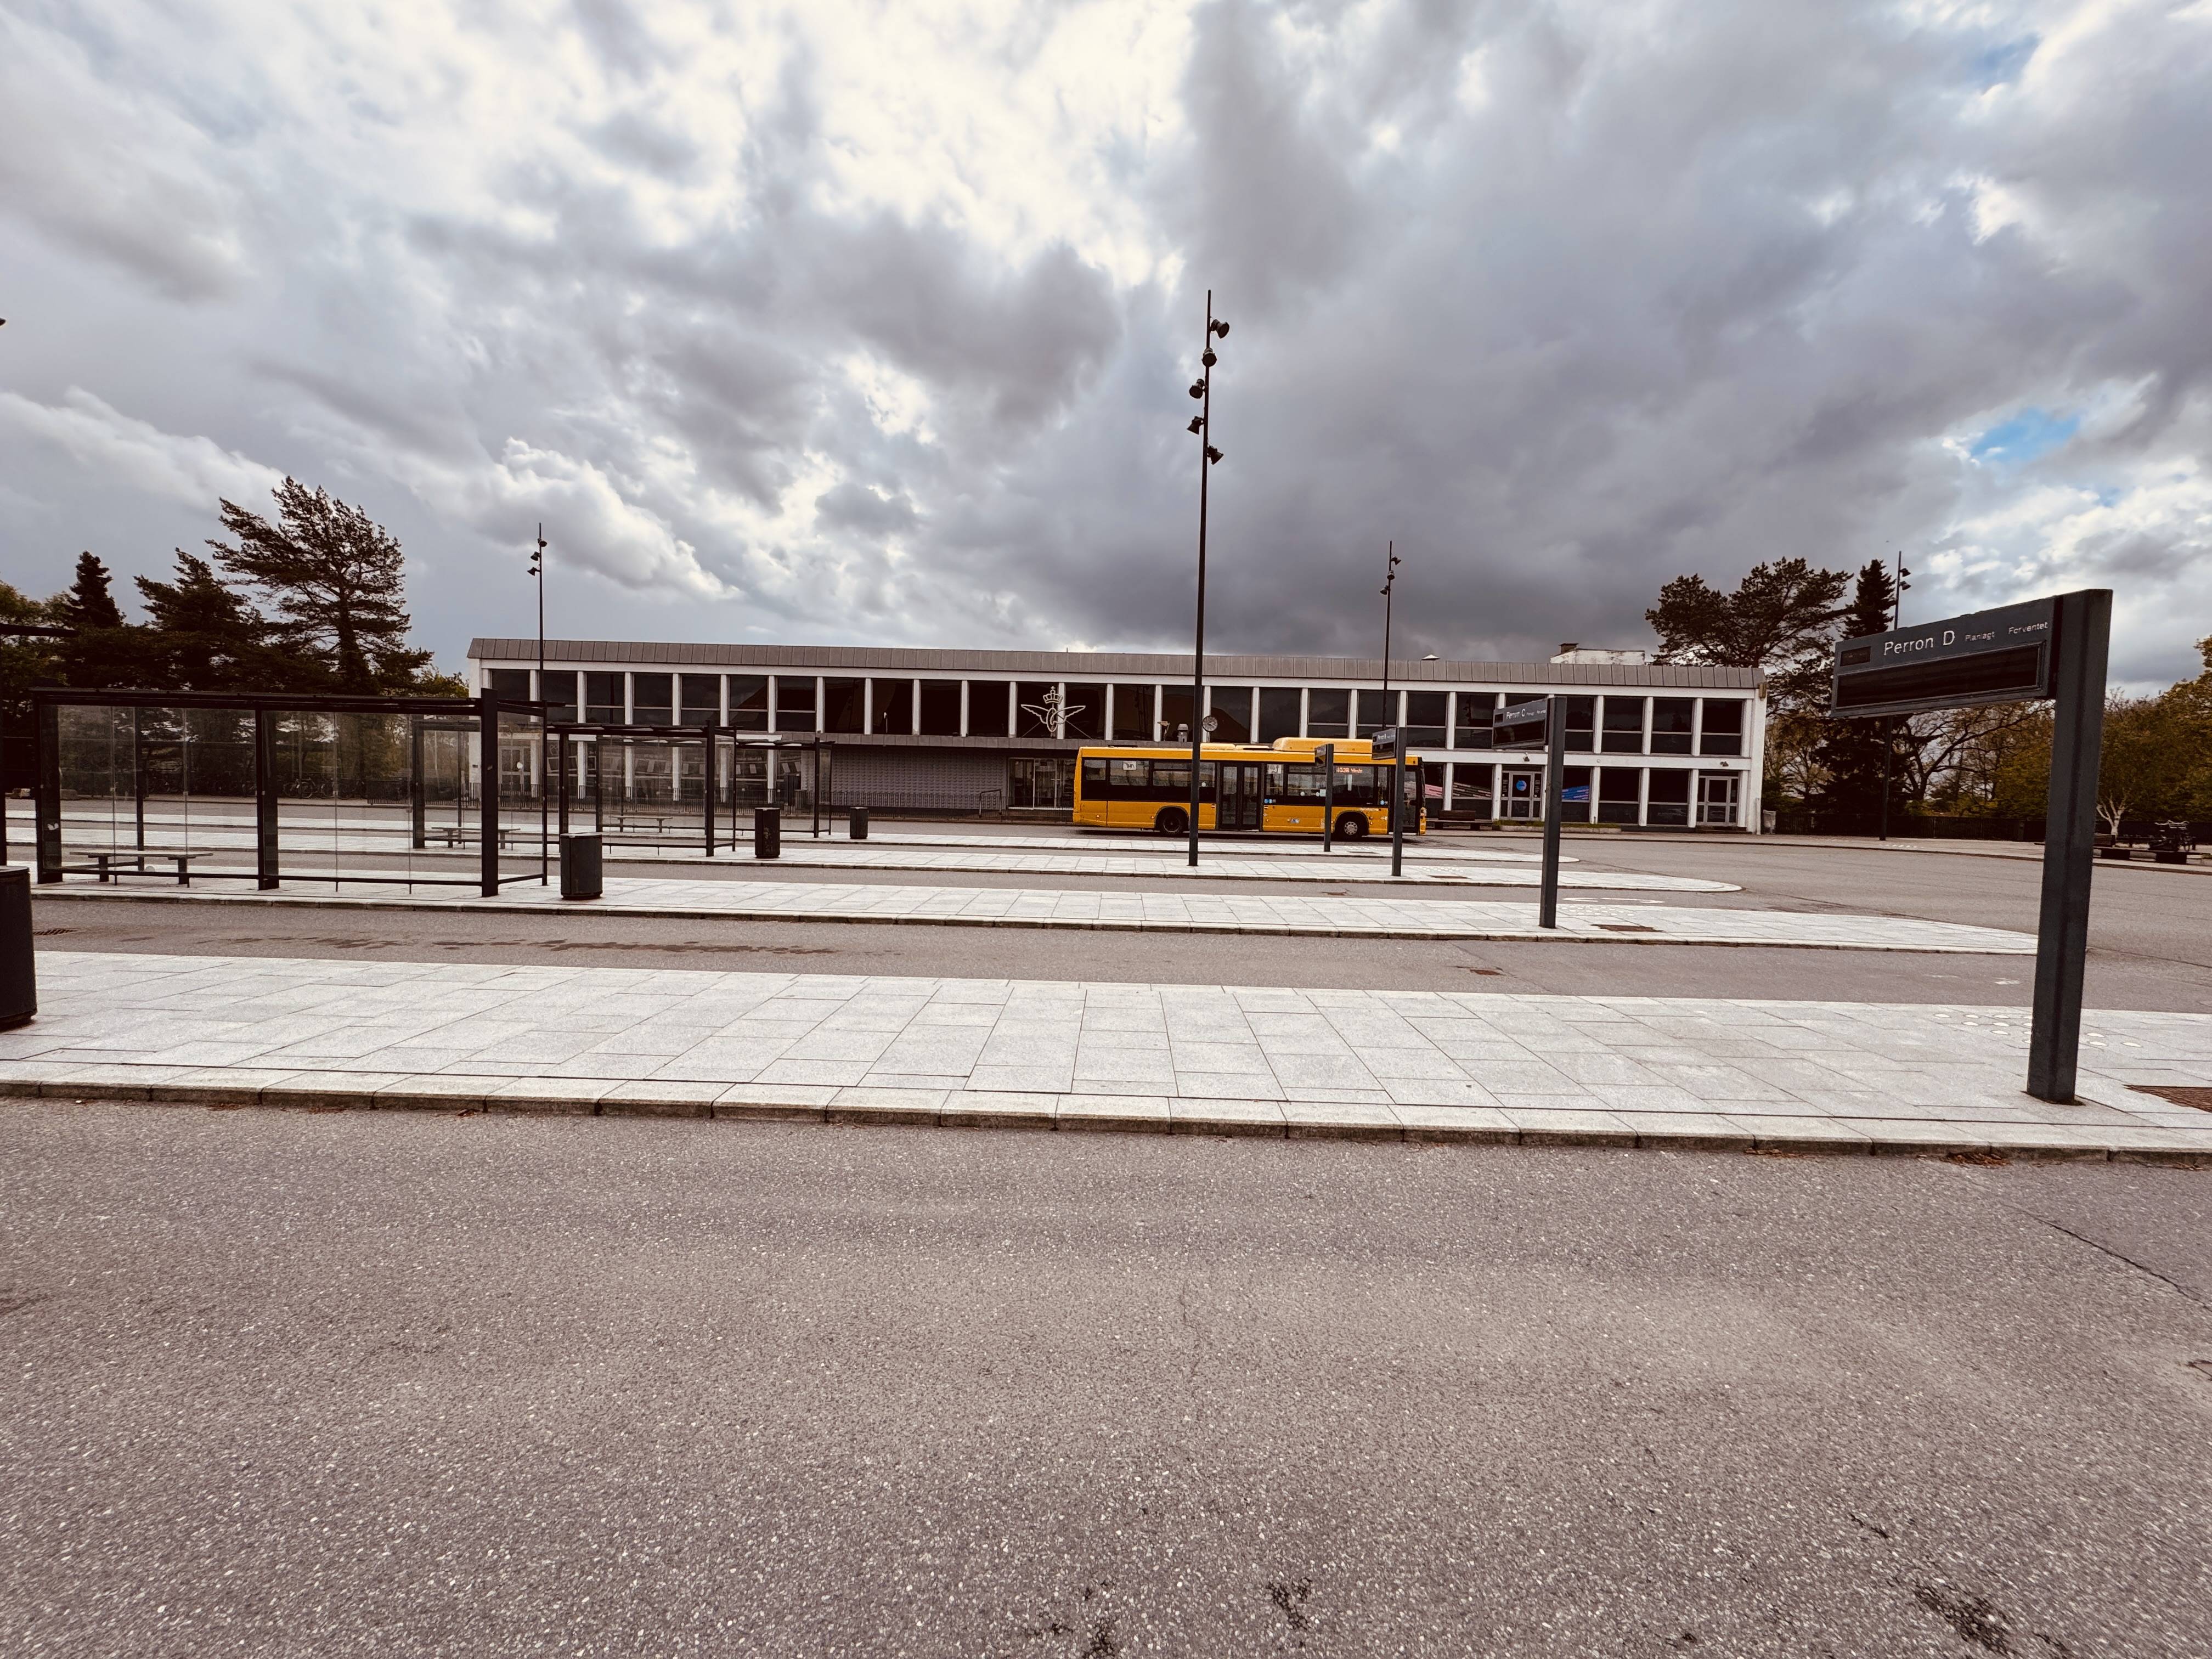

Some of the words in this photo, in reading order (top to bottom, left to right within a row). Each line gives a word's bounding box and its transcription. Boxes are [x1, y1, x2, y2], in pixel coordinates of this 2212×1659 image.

[1883, 637, 1933, 656] Perron
[1943, 630, 1955, 646] D
[2008, 622, 2048, 634] Forventet
[1521, 708, 1525, 717] C
